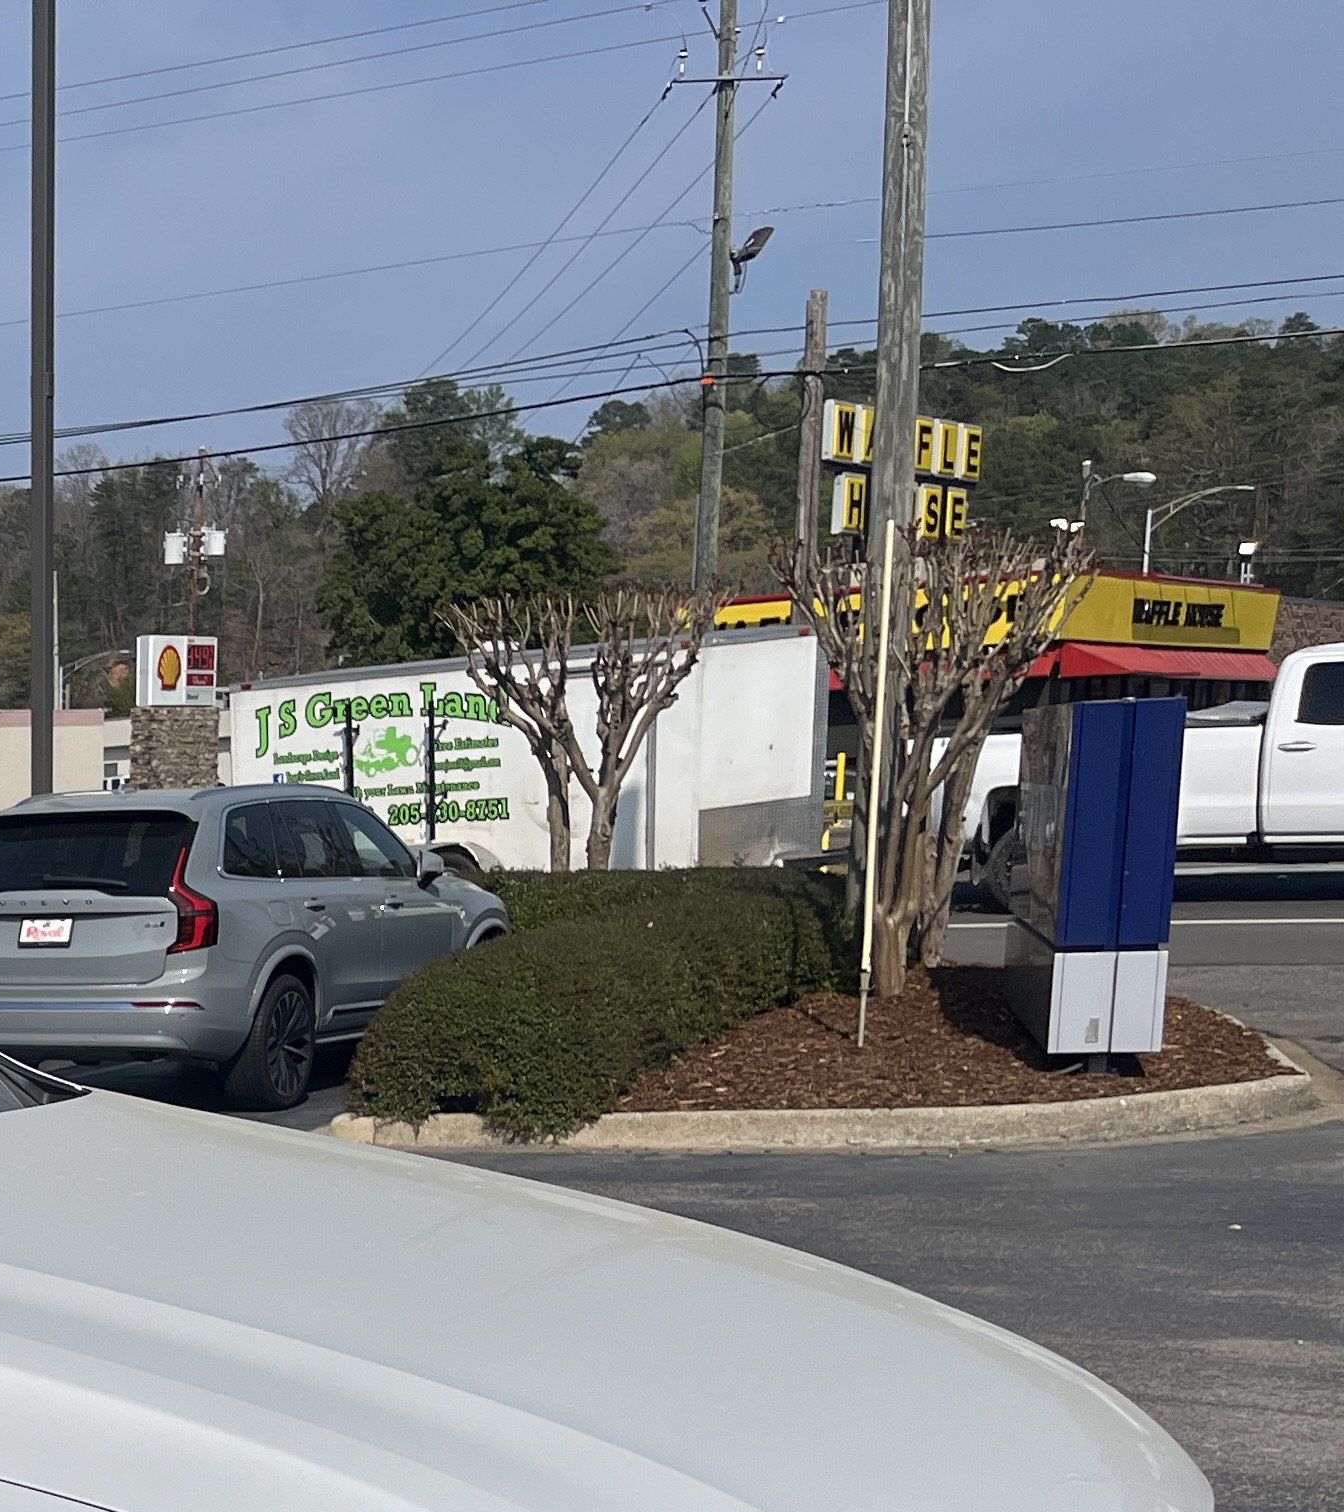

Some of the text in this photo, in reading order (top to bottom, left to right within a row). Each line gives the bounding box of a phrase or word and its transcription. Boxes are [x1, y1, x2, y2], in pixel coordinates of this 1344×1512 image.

[838, 409, 981, 473] WFLE
[848, 483, 964, 536] HSE
[255, 706, 271, 758] J
[278, 699, 298, 738] S
[305, 692, 414, 728] Green
[388, 797, 509, 826] 205-30-8751
